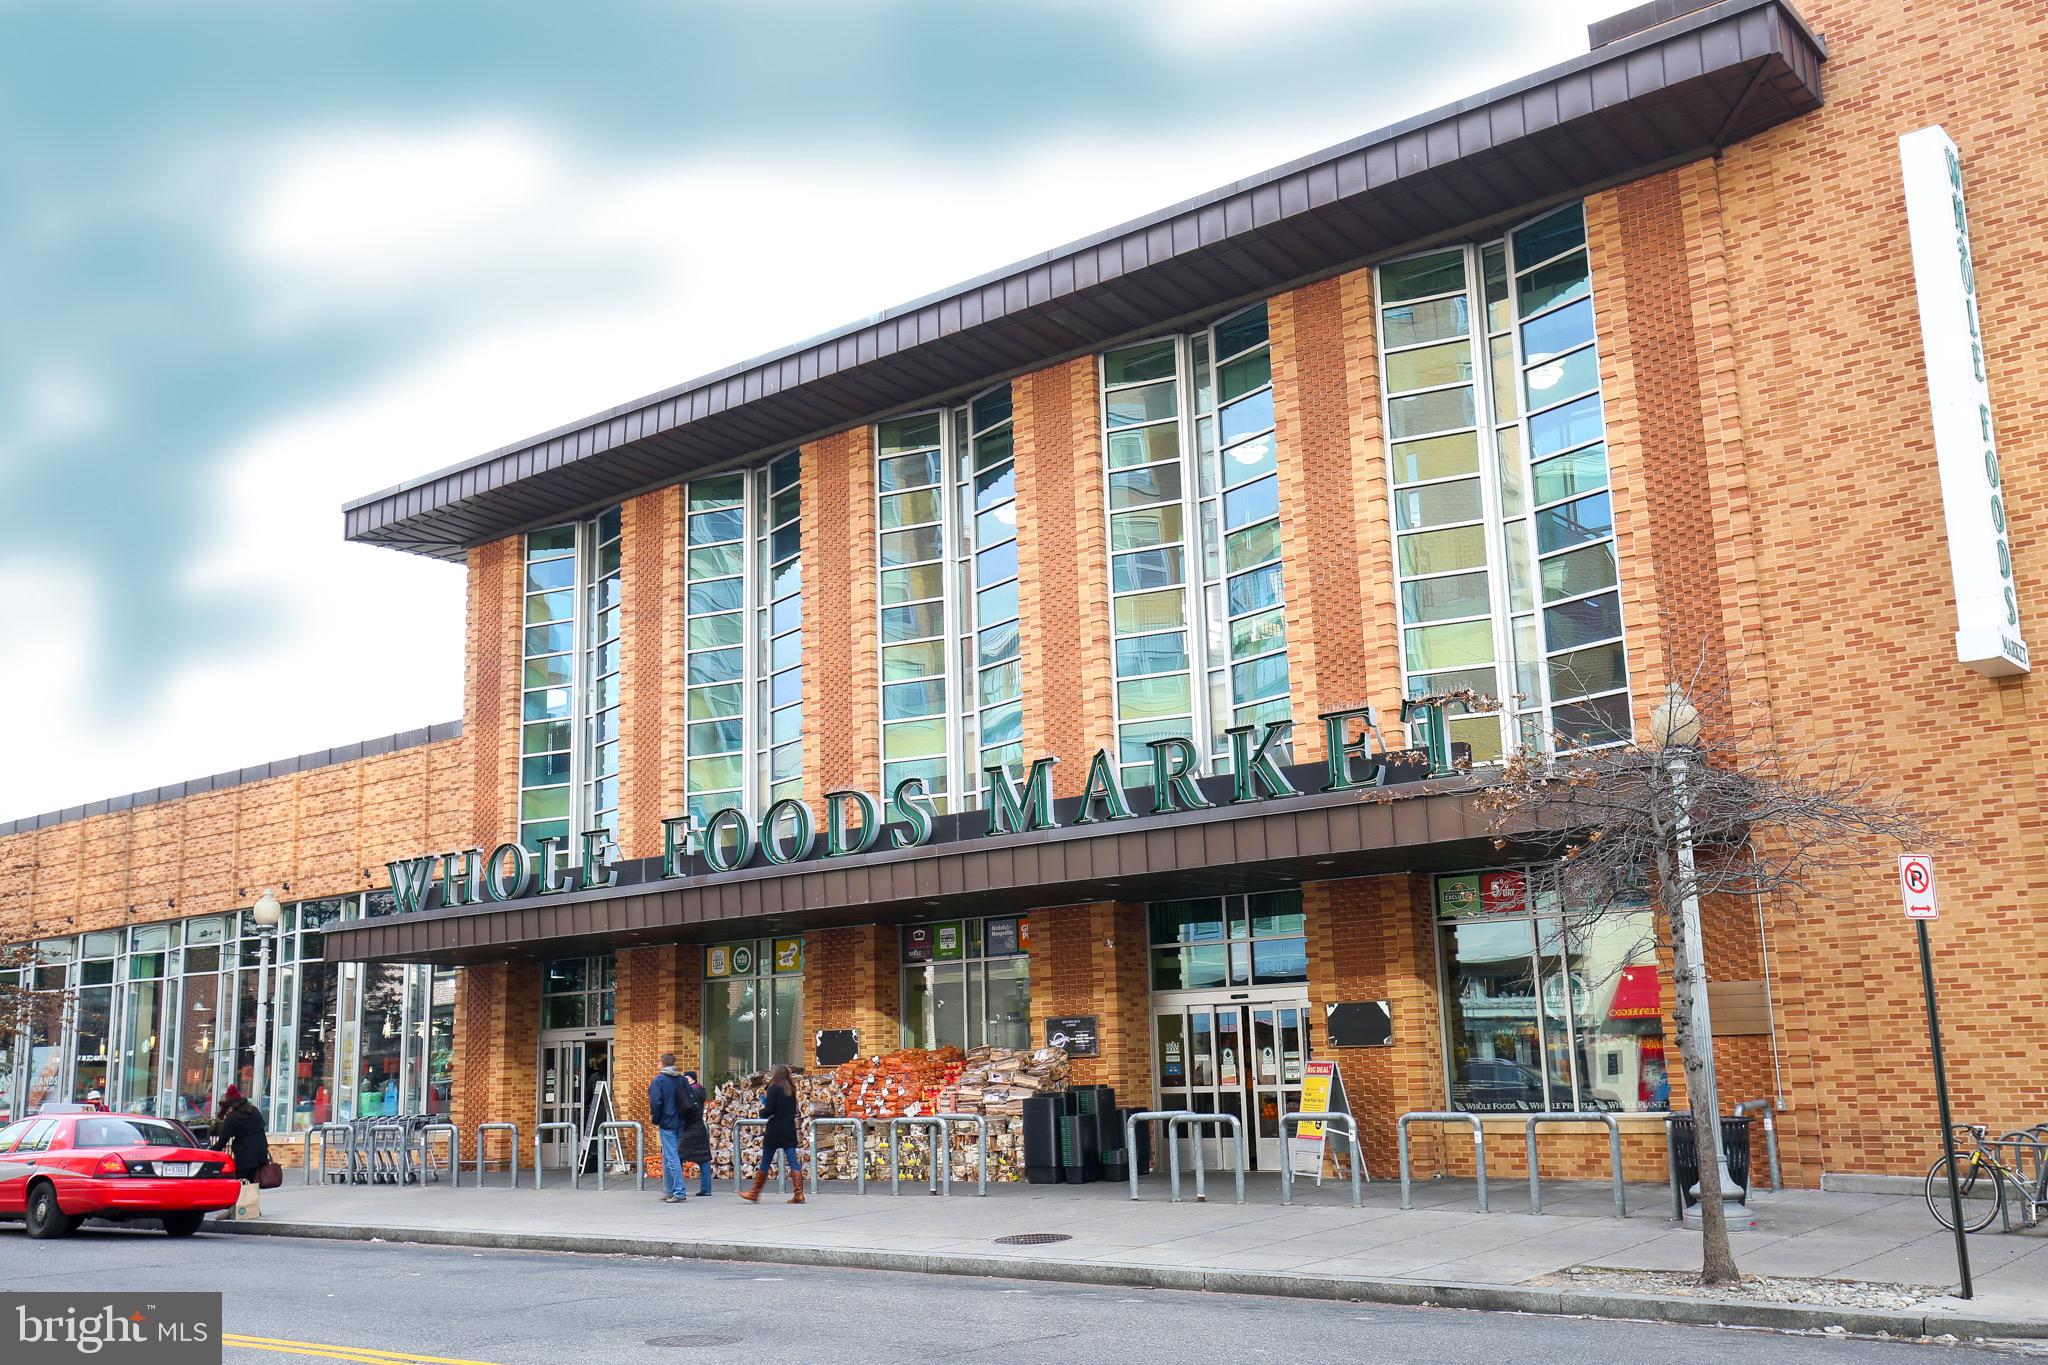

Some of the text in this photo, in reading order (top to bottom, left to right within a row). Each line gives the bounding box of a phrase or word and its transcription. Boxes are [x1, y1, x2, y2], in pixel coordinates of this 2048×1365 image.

[1979, 403, 2017, 627] FOODS
[2001, 634, 2028, 665] MARKET
[384, 697, 1472, 913] WHOLE FOODS MARKET
[1316, 1065, 1330, 1073] DEAL
